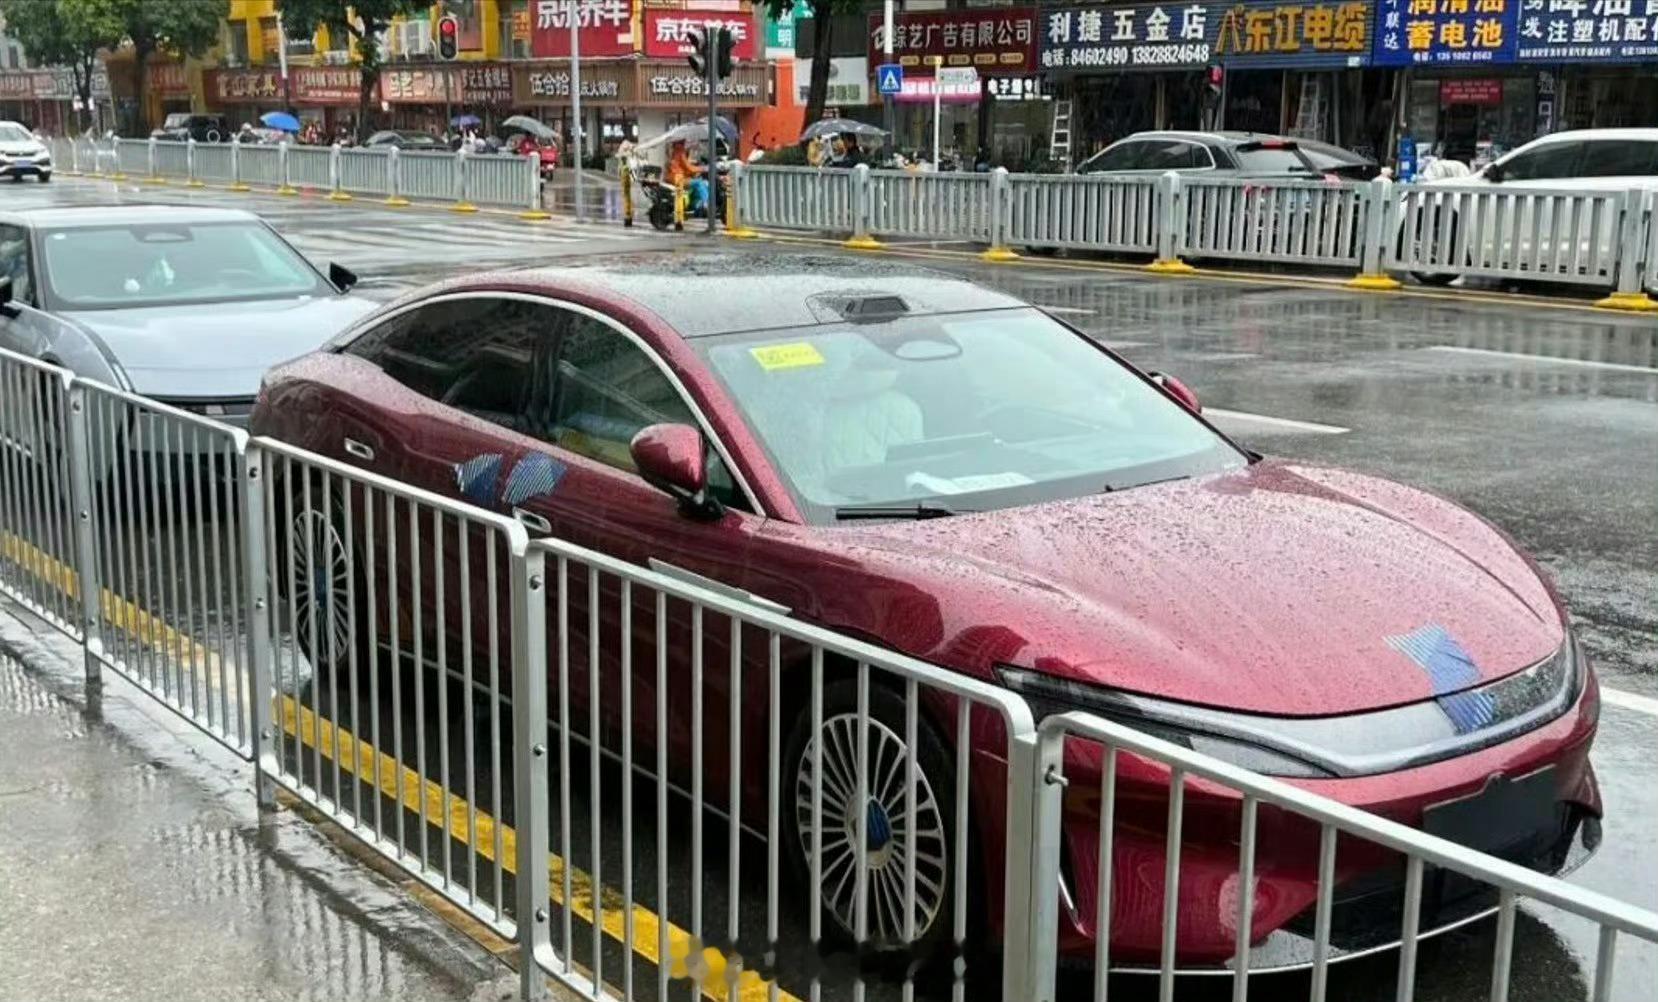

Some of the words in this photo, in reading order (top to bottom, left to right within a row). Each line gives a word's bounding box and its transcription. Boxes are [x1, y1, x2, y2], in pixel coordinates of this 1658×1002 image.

[1048, 5, 1207, 43] 利捷五金店
[1244, 3, 1367, 52] 东江电缆
[1405, 19, 1503, 49] 蓄电池
[1547, 17, 1658, 42] 注塑机配
